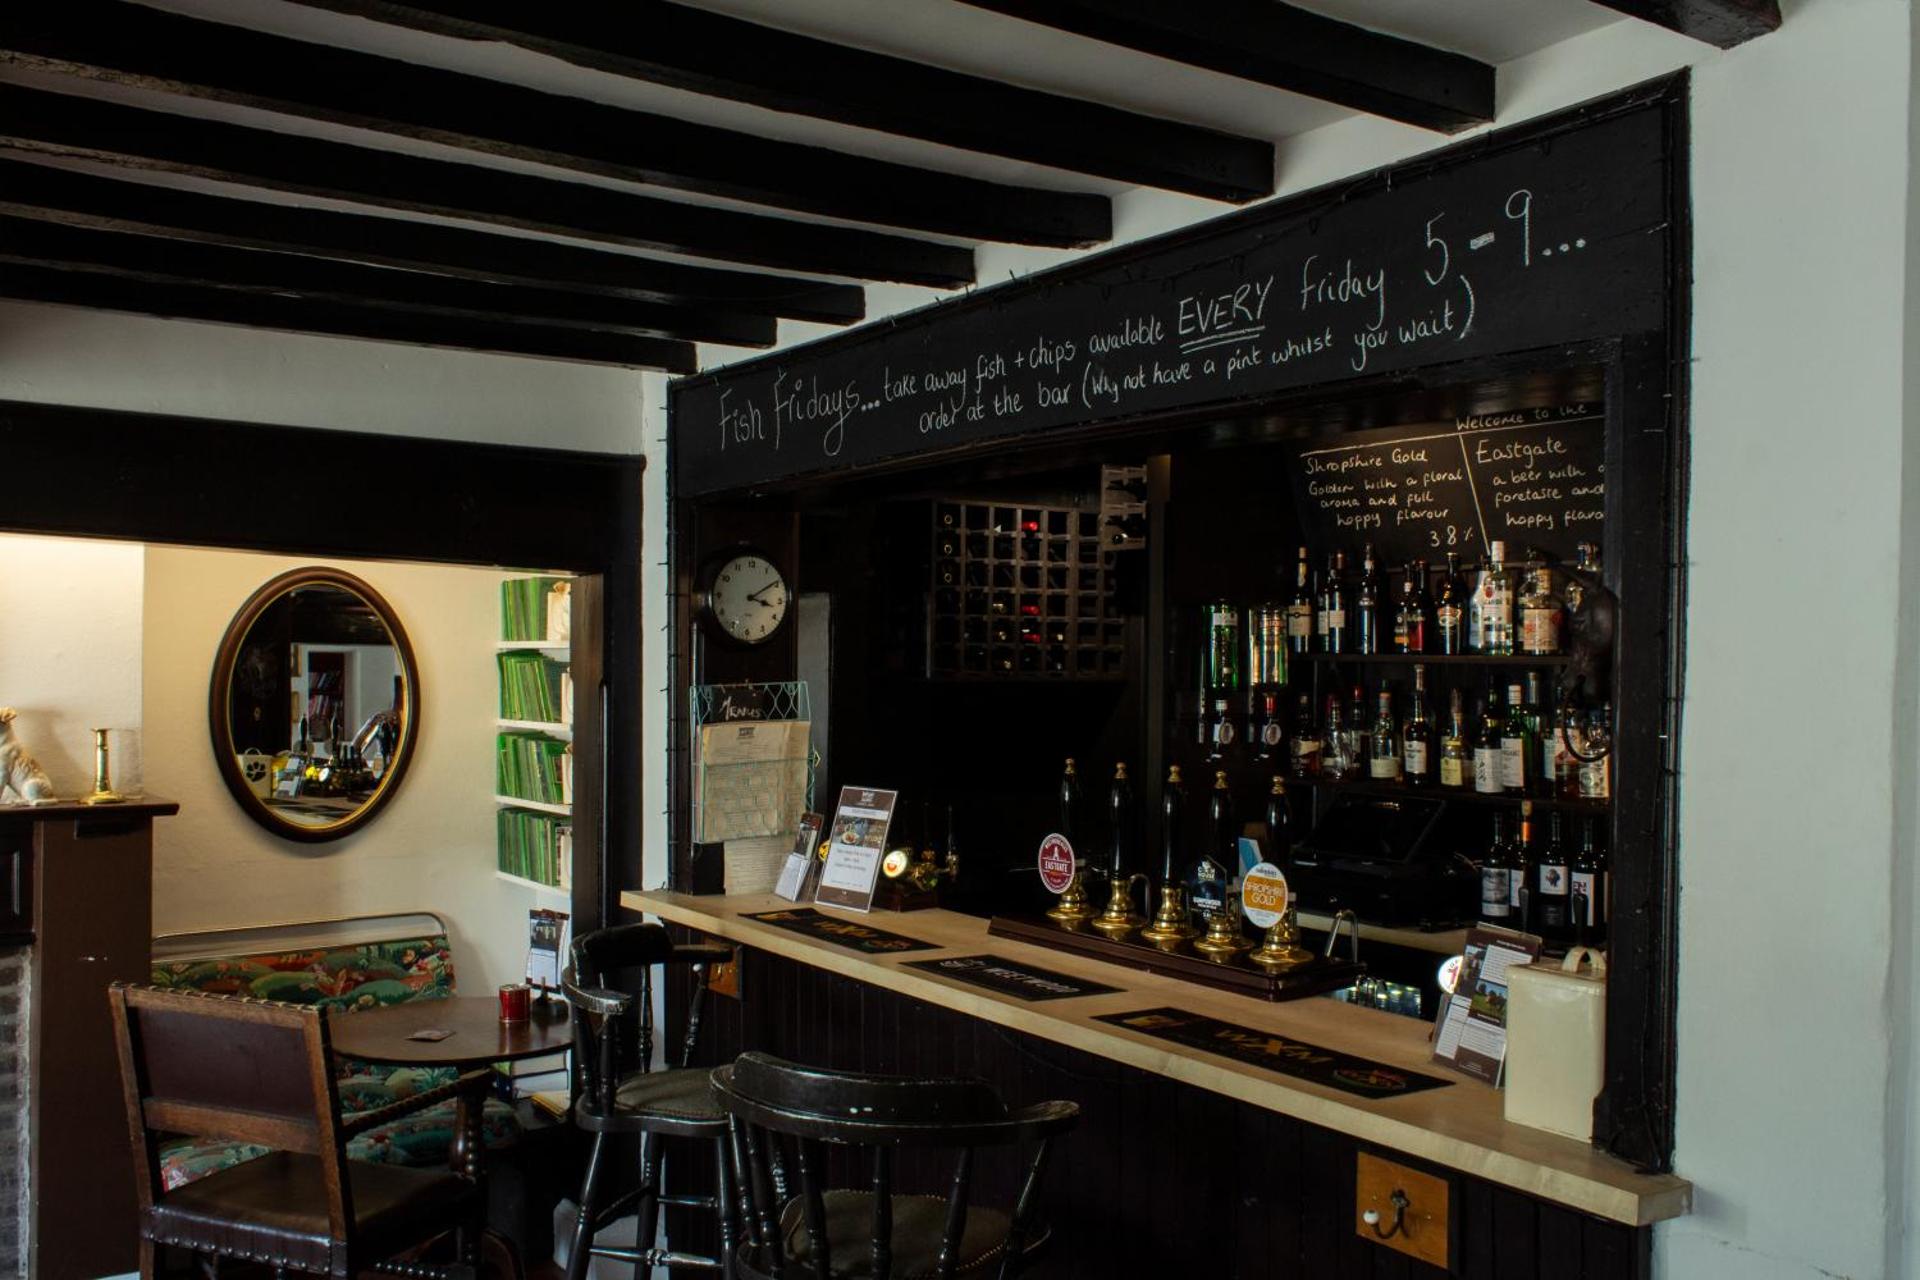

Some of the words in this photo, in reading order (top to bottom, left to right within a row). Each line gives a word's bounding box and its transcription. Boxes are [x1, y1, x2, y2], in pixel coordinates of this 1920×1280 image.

[718, 387, 765, 451] Fish
[884, 367, 918, 402] take
[924, 368, 967, 411] away
[976, 353, 1007, 394] fish
[1029, 336, 1075, 374] chips
[1088, 315, 1165, 353] available
[1178, 275, 1274, 336] EVERY
[919, 402, 961, 434] order
[966, 403, 985, 422] at
[993, 385, 1023, 417] the
[1038, 381, 1072, 408] bar
[1123, 364, 1147, 390] not
[1153, 361, 1192, 386] have
[1203, 359, 1216, 374] a
[1227, 348, 1262, 379] pint
[1271, 327, 1334, 365] whilst
[1352, 330, 1388, 372] you
[1399, 274, 1475, 344] wait)
[1456, 416, 1525, 431] Welcome
[1535, 407, 1550, 419] to
[1559, 404, 1588, 416] the
[1305, 455, 1382, 475] Shropshire
[1392, 448, 1429, 465] Gold
[1475, 436, 1568, 469] Eastgate
[1308, 481, 1354, 496] Golden
[1364, 478, 1398, 490] with
[1406, 476, 1418, 486] a
[1423, 469, 1464, 487] floral
[1493, 476, 1507, 486] a
[1511, 469, 1542, 484] beer
[1549, 464, 1586, 480] with
[1320, 498, 1361, 508] aroma
[1368, 494, 1398, 506] and
[1407, 490, 1435, 507] full
[1495, 487, 1563, 508] foretaste
[1571, 484, 1605, 496] and
[1336, 512, 1382, 530] hoppy
[1397, 509, 1449, 526] flavour
[1506, 512, 1554, 530] hoppy
